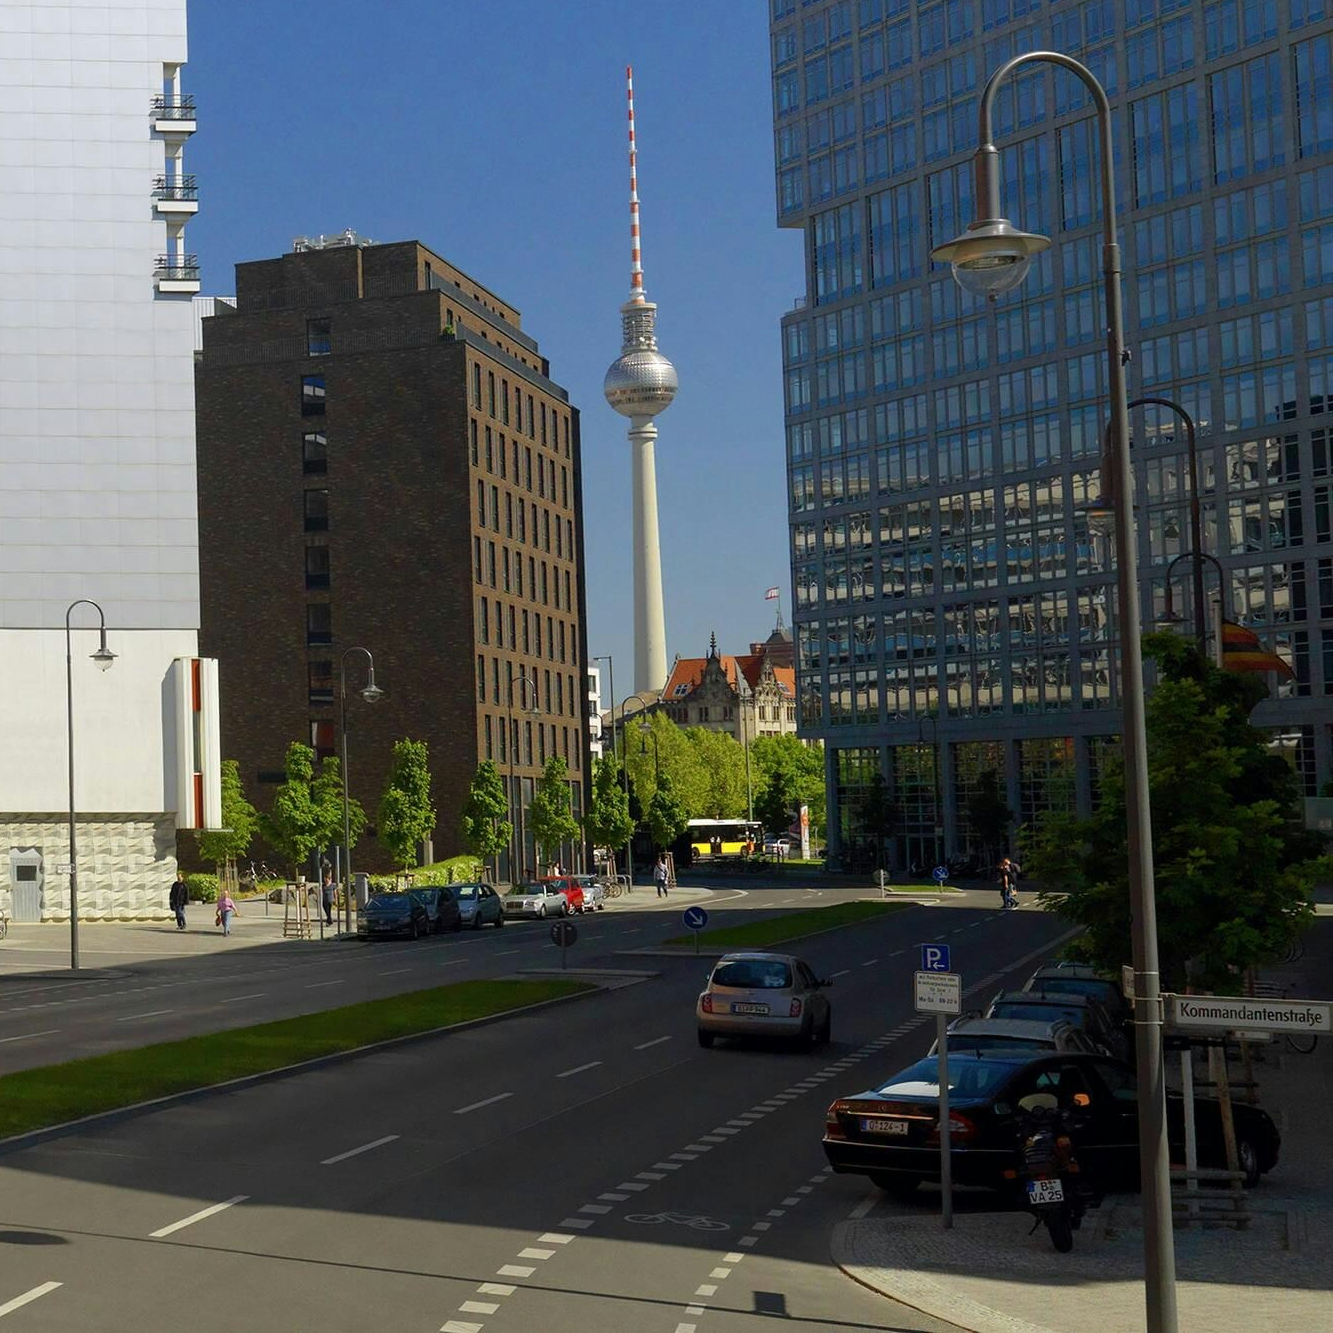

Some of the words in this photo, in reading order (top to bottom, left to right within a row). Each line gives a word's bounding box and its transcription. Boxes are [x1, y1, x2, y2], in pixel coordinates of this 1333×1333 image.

[926, 947, 941, 968] P
[1180, 1002, 1323, 1027] Kommandantenstraße
[1040, 1181, 1048, 1192] B
[1047, 1191, 1062, 1201] 25
